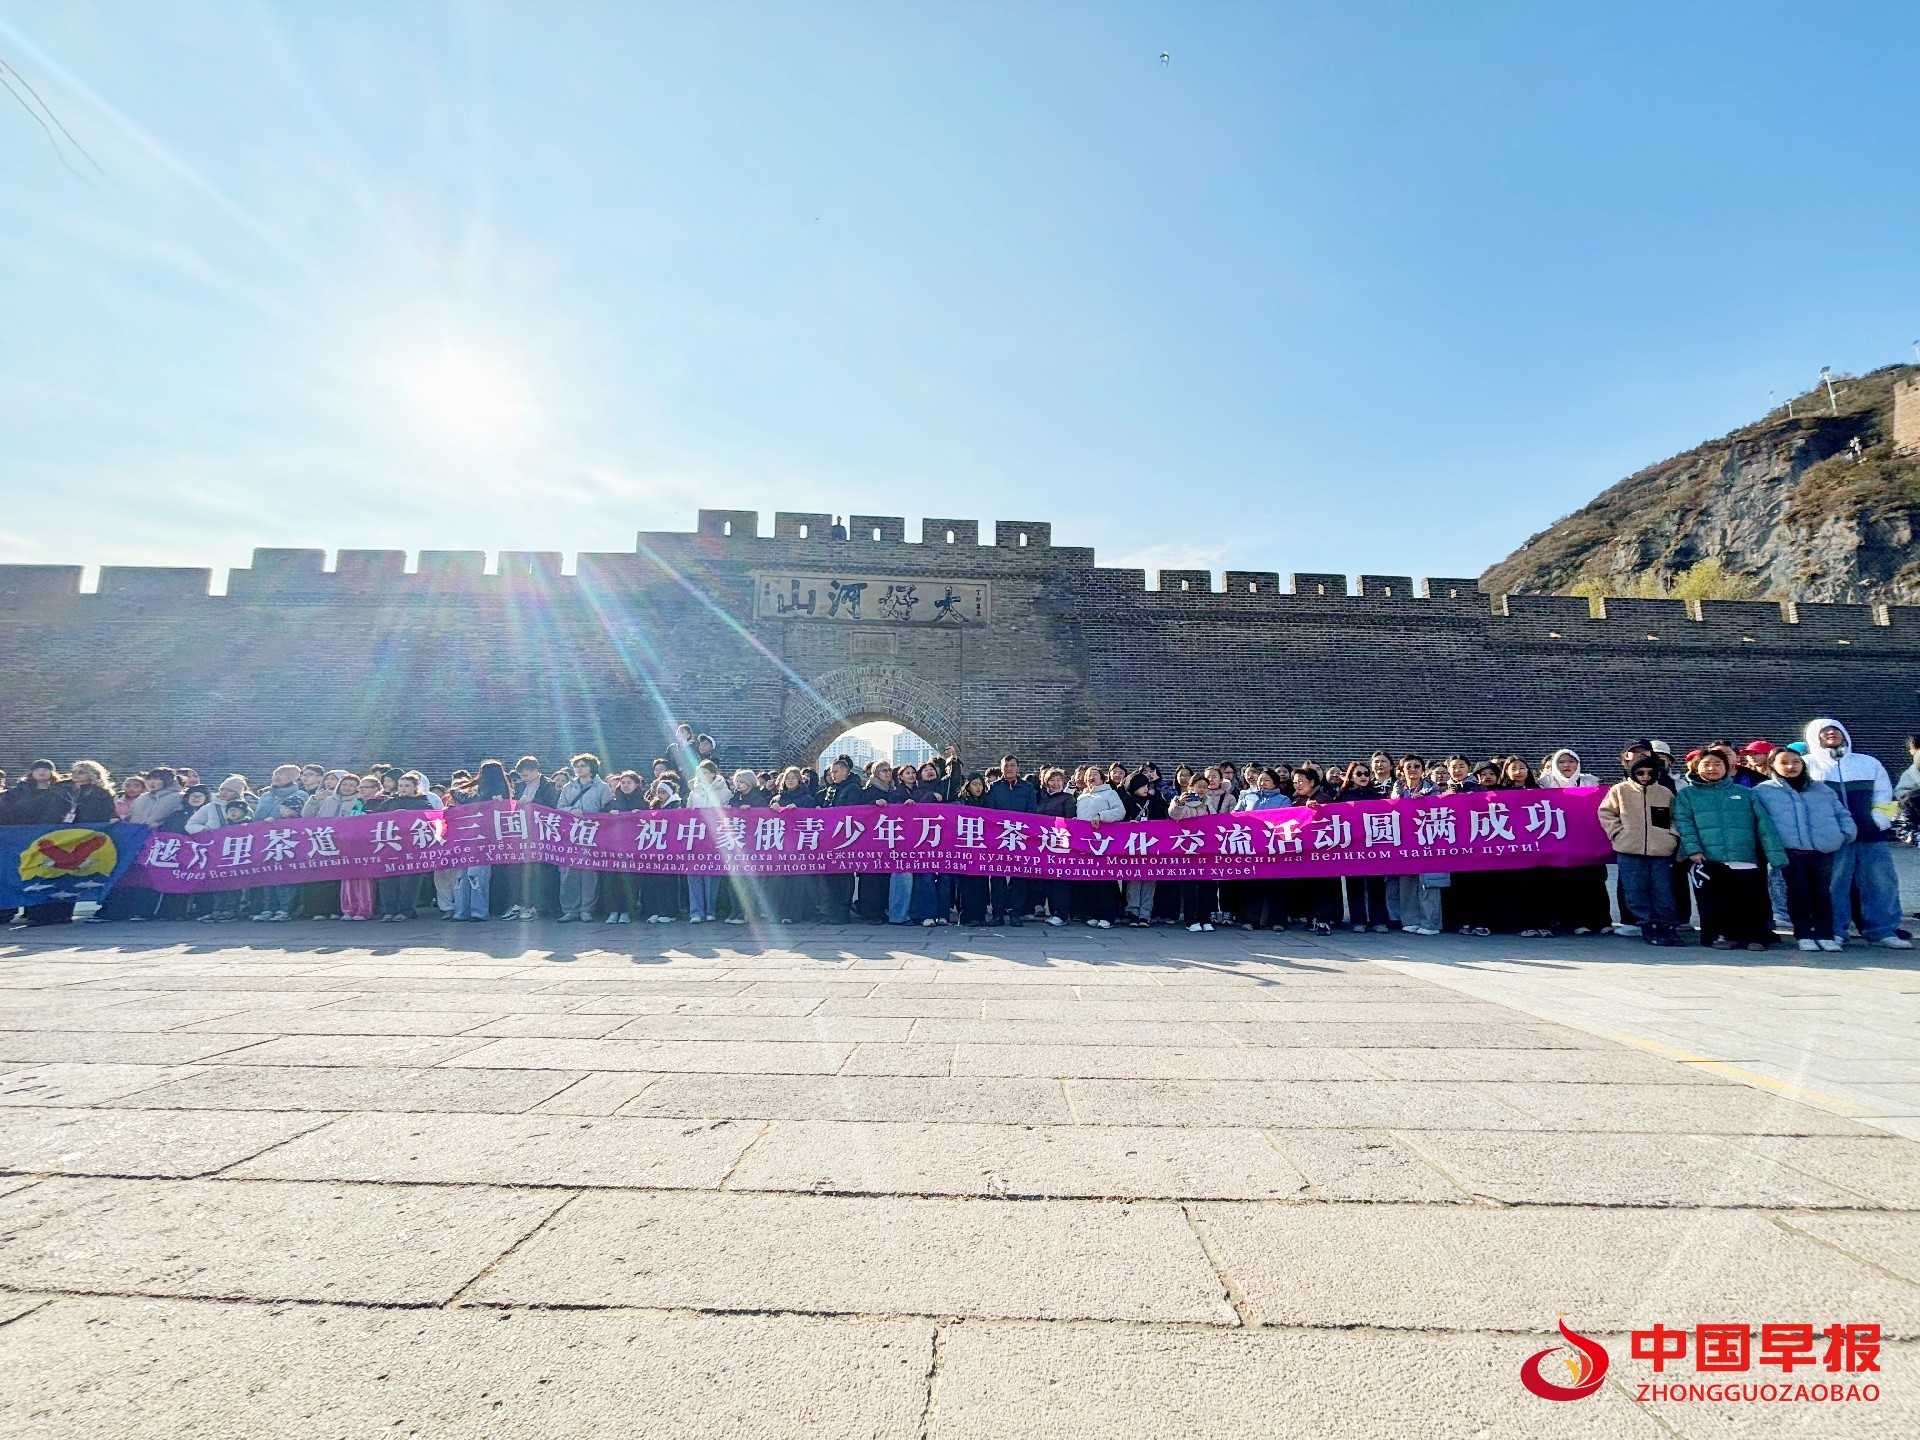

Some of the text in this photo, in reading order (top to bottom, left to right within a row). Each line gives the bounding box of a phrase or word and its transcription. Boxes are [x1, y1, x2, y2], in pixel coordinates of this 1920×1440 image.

[369, 809, 600, 854] 共叙三国情谊
[634, 800, 1567, 856] 祝中蒙俄青少年万里茶道文化交流活动圆满成功
[172, 869, 206, 881] Через
[210, 862, 283, 880] Великий
[288, 856, 350, 870] чайный
[420, 845, 471, 860] дружбе
[477, 841, 514, 852] трёх
[581, 847, 634, 860] Желаем
[640, 853, 721, 862] огромного
[725, 853, 773, 863] успеха
[778, 850, 884, 861] молодёжному
[889, 849, 973, 861] фестивалю
[978, 853, 1041, 865] культур
[1046, 854, 1101, 867] Китая,
[1106, 855, 1192, 865] Монголии
[1198, 856, 1208, 865] и
[1214, 855, 1277, 864] России
[1310, 850, 1392, 862] Великом
[1398, 846, 1474, 858] чайном
[1482, 841, 1541, 856] пути!
[440, 857, 480, 867] Орос,
[485, 852, 526, 861] Хятад
[693, 862, 739, 871] соёлын
[743, 863, 826, 872] солилцооны
[895, 860, 940, 870] Цайны
[979, 864, 1042, 875] наадмын
[1047, 867, 1142, 877] оролцогчдод
[1147, 867, 1205, 877] амжилт
